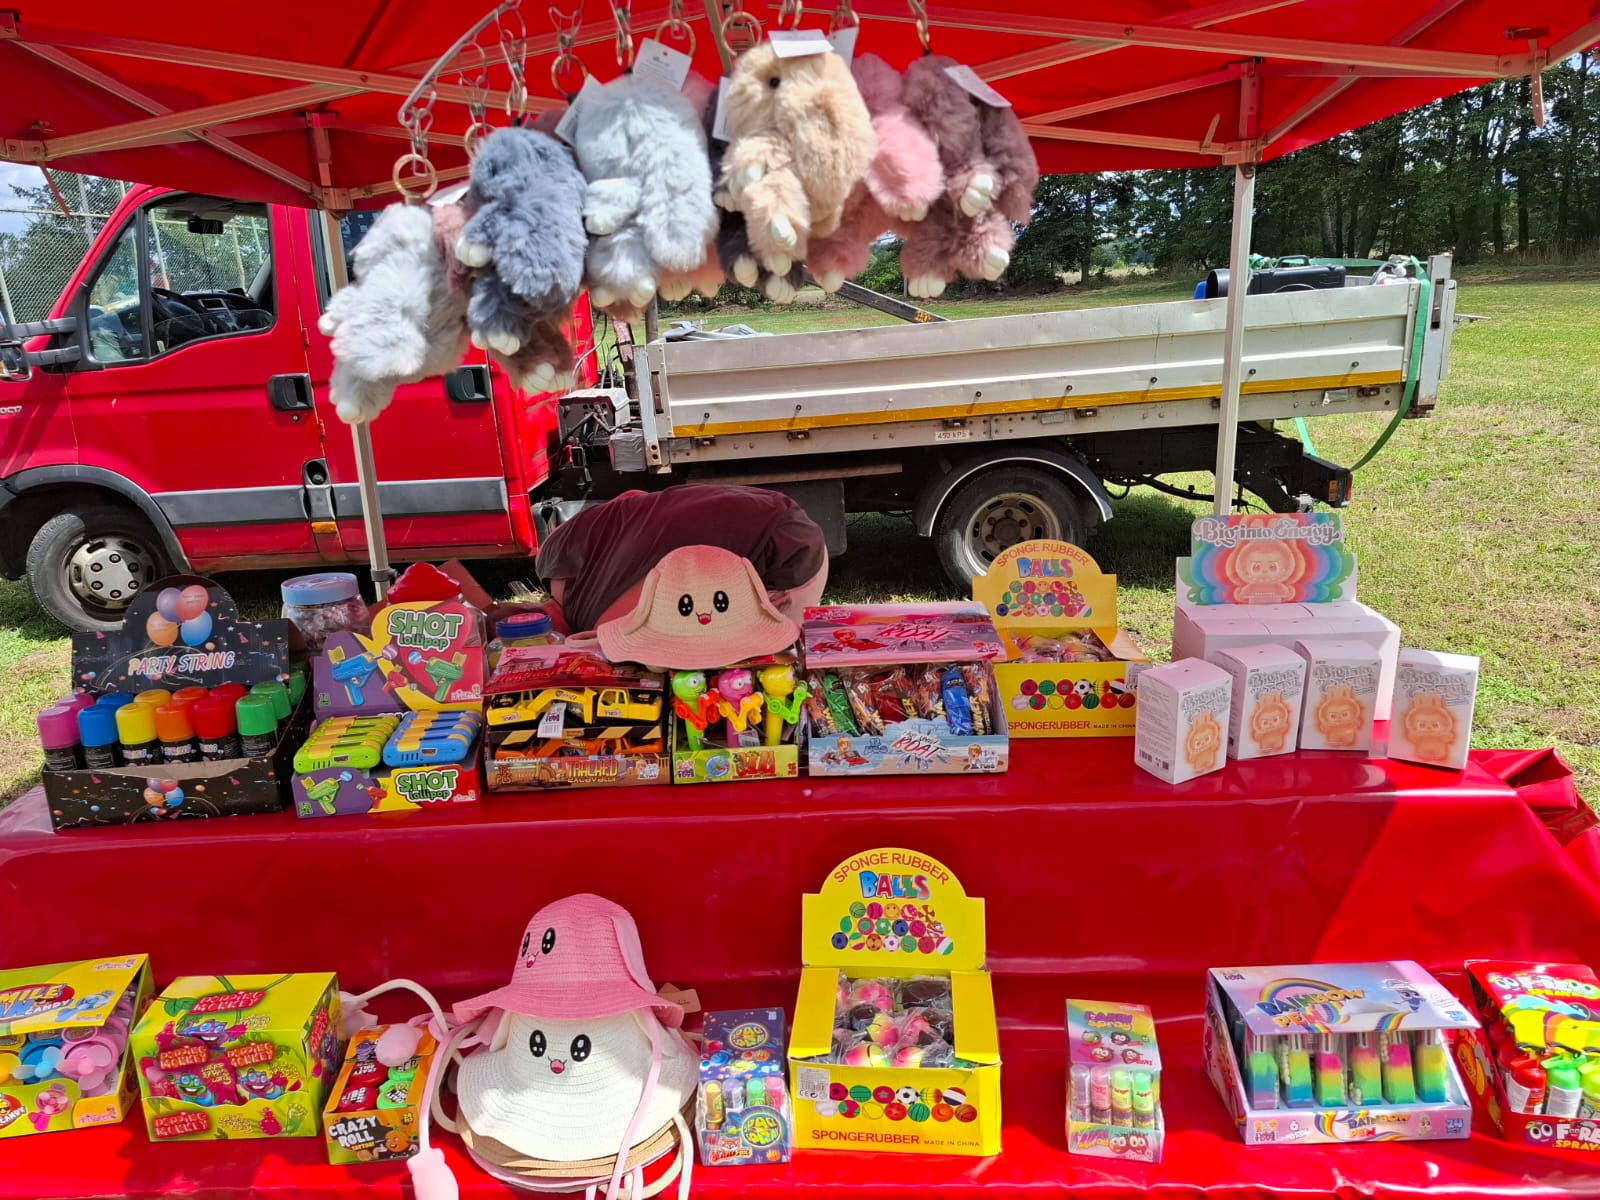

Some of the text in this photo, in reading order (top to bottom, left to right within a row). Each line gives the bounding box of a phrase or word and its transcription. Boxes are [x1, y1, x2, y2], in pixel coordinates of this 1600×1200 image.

[1193, 518, 1340, 547] Big into Energy
[997, 543, 1089, 568] SPONGE RUBBER
[1017, 557, 1074, 578] BALLS
[389, 611, 463, 638] SHOT
[128, 651, 235, 676] PARTY STRING
[1008, 721, 1090, 730] SPONGERUBBER
[397, 771, 457, 793] SHOT
[834, 852, 950, 885] SPONGE RUBBER
[859, 871, 931, 900] BALLS
[25, 999, 72, 1015] CANDY
[1255, 988, 1366, 1017] RAINBOW
[1272, 1004, 1326, 1028] PEN
[328, 1116, 377, 1137] CRAZY
[1350, 1114, 1410, 1128] RAINBOW
[338, 1131, 374, 1147] ROLL
[812, 1129, 919, 1145] SPONGERUBBER
[1350, 1127, 1376, 1138] PEN
